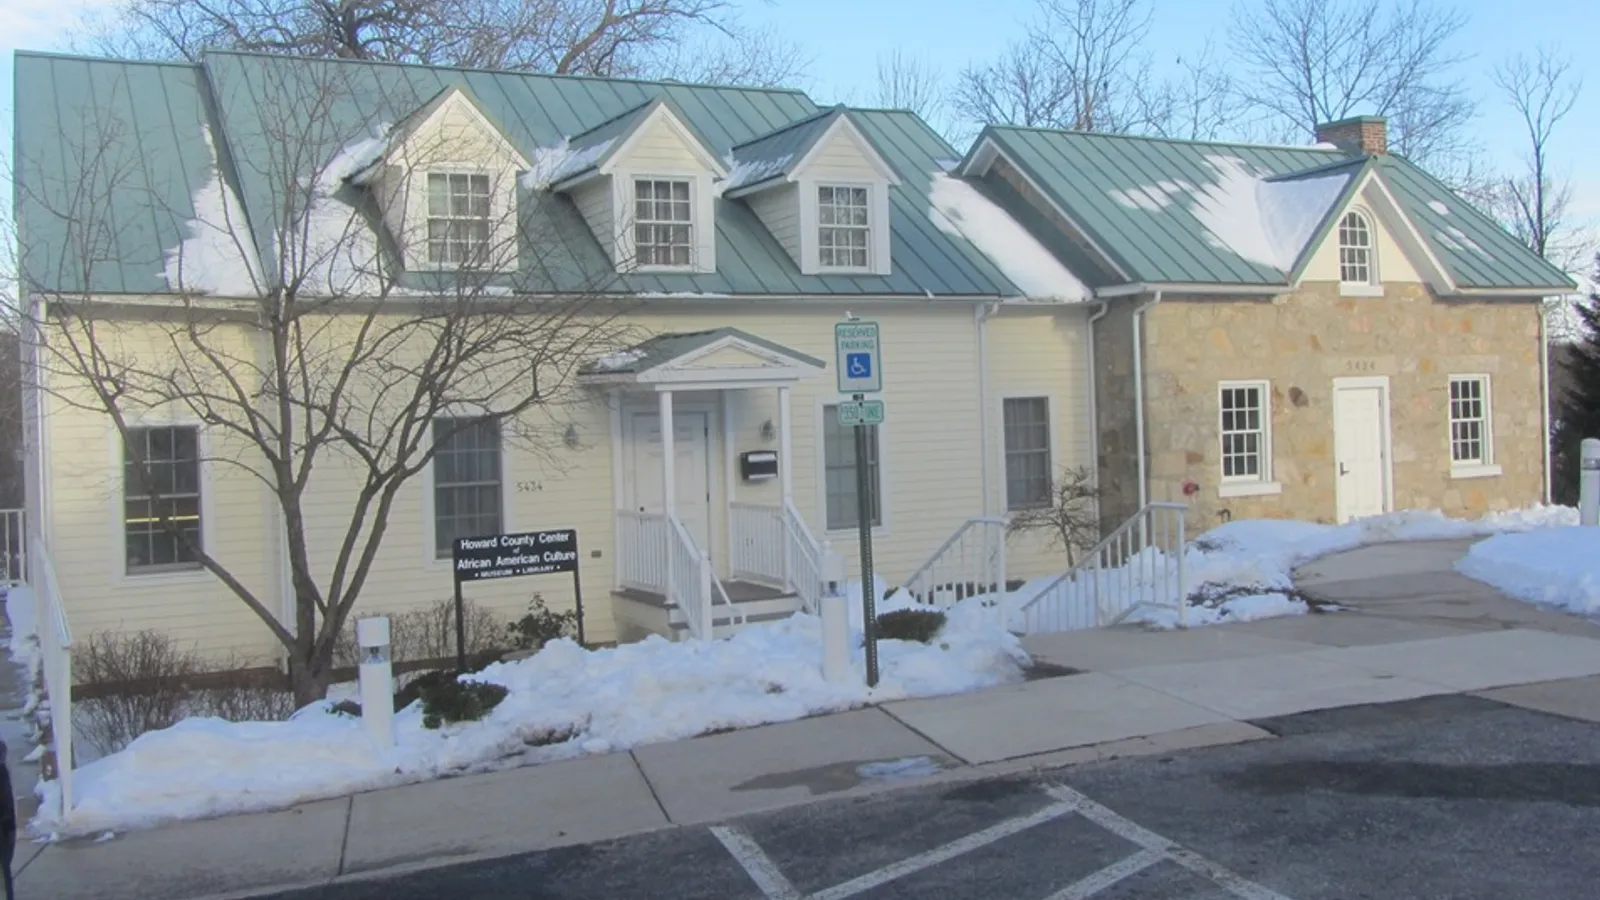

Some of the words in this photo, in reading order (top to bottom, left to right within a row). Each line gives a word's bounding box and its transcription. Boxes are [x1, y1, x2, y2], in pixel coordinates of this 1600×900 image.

[838, 327, 877, 338] RESERVED
[841, 340, 875, 350] PARKING
[516, 480, 543, 492] 5434
[461, 537, 498, 550] Howard
[500, 534, 535, 547] County
[539, 532, 570, 544] Center
[457, 558, 492, 570] African
[495, 554, 540, 567] American
[543, 551, 576, 563] Culture
[480, 569, 513, 578] MUSEUM
[522, 565, 555, 574] LIBRARY
